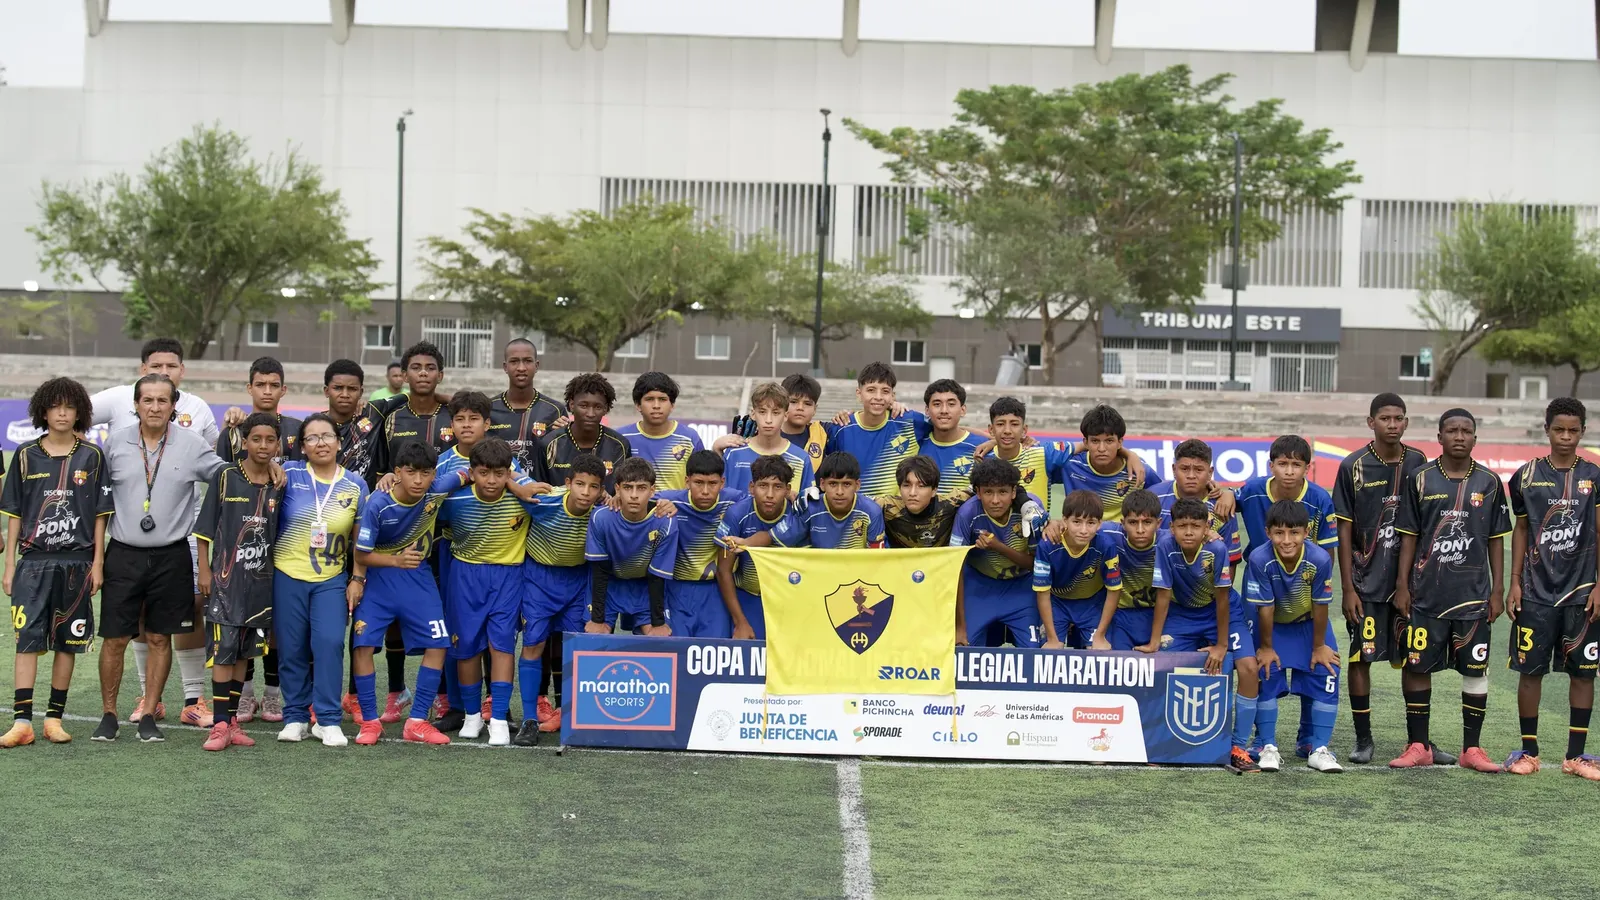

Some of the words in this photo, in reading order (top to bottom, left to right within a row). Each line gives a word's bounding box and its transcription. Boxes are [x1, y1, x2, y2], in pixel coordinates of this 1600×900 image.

[1140, 312, 1232, 329] TRIBUNA
[1246, 315, 1301, 331] ESTE
[36, 516, 80, 538] PONY
[242, 516, 268, 524] DISCOVER
[1540, 522, 1582, 544] PONY
[236, 544, 270, 562] PONY
[1432, 538, 1474, 554] PONY
[429, 620, 448, 638] 31
[1230, 632, 1241, 650] 2
[1407, 626, 1428, 650] 18
[687, 645, 744, 676] COPA
[954, 652, 1027, 683] LEGIAL
[1034, 654, 1154, 687] MARATHON
[580, 679, 670, 694] marathon
[604, 697, 644, 707] SPORTS
[862, 708, 914, 716] PICHINCHA
[923, 704, 965, 716] deuna!
[1076, 711, 1119, 721] Pronaca
[740, 712, 785, 725] JUNTA
[790, 714, 807, 725] DE
[740, 728, 838, 741] BENEFICENCIA
[863, 726, 902, 738] SPORADE
[1022, 732, 1058, 743] Hispana
